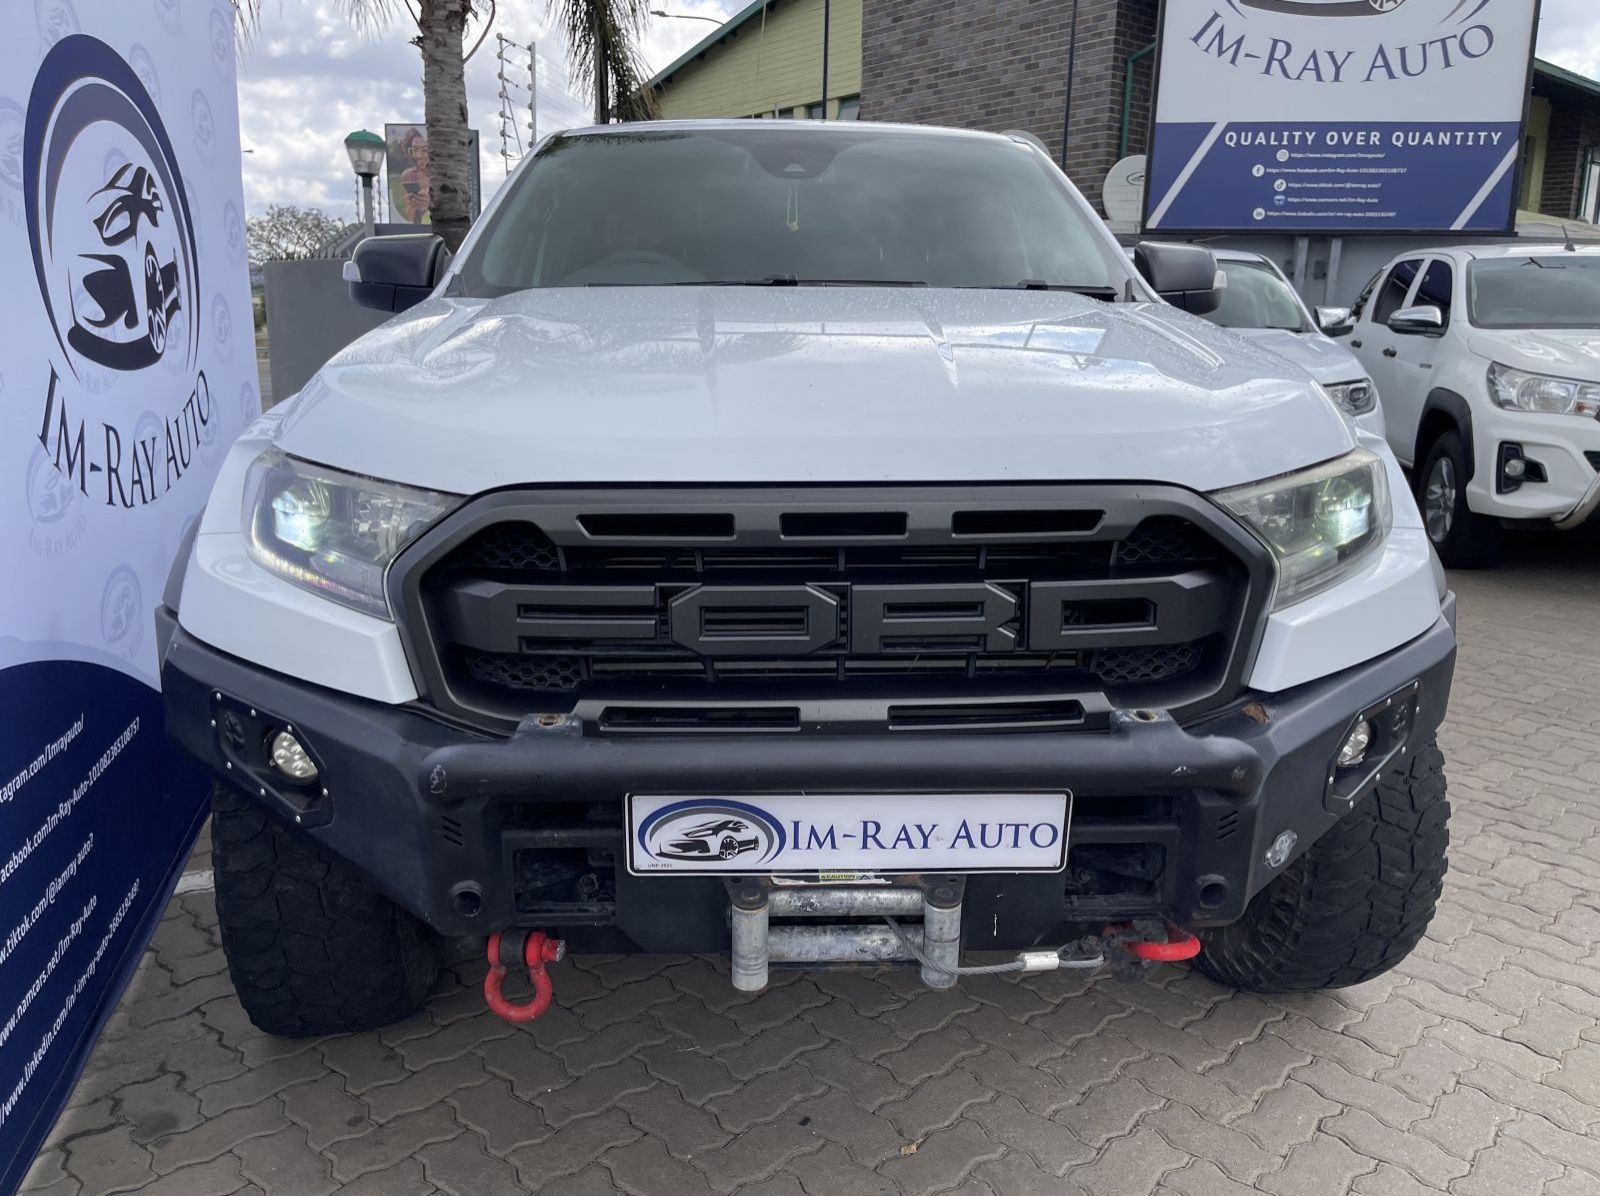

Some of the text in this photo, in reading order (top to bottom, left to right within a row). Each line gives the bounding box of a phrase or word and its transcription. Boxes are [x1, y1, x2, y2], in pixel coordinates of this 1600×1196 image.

[1360, 24, 1494, 83] AUTO
[1224, 131, 1503, 147] QUALITY OVER QUANTITY
[165, 369, 210, 492] AUTO
[450, 572, 1213, 655] FORD
[77, 832, 94, 865] auto?
[948, 818, 1059, 850] AUTO
